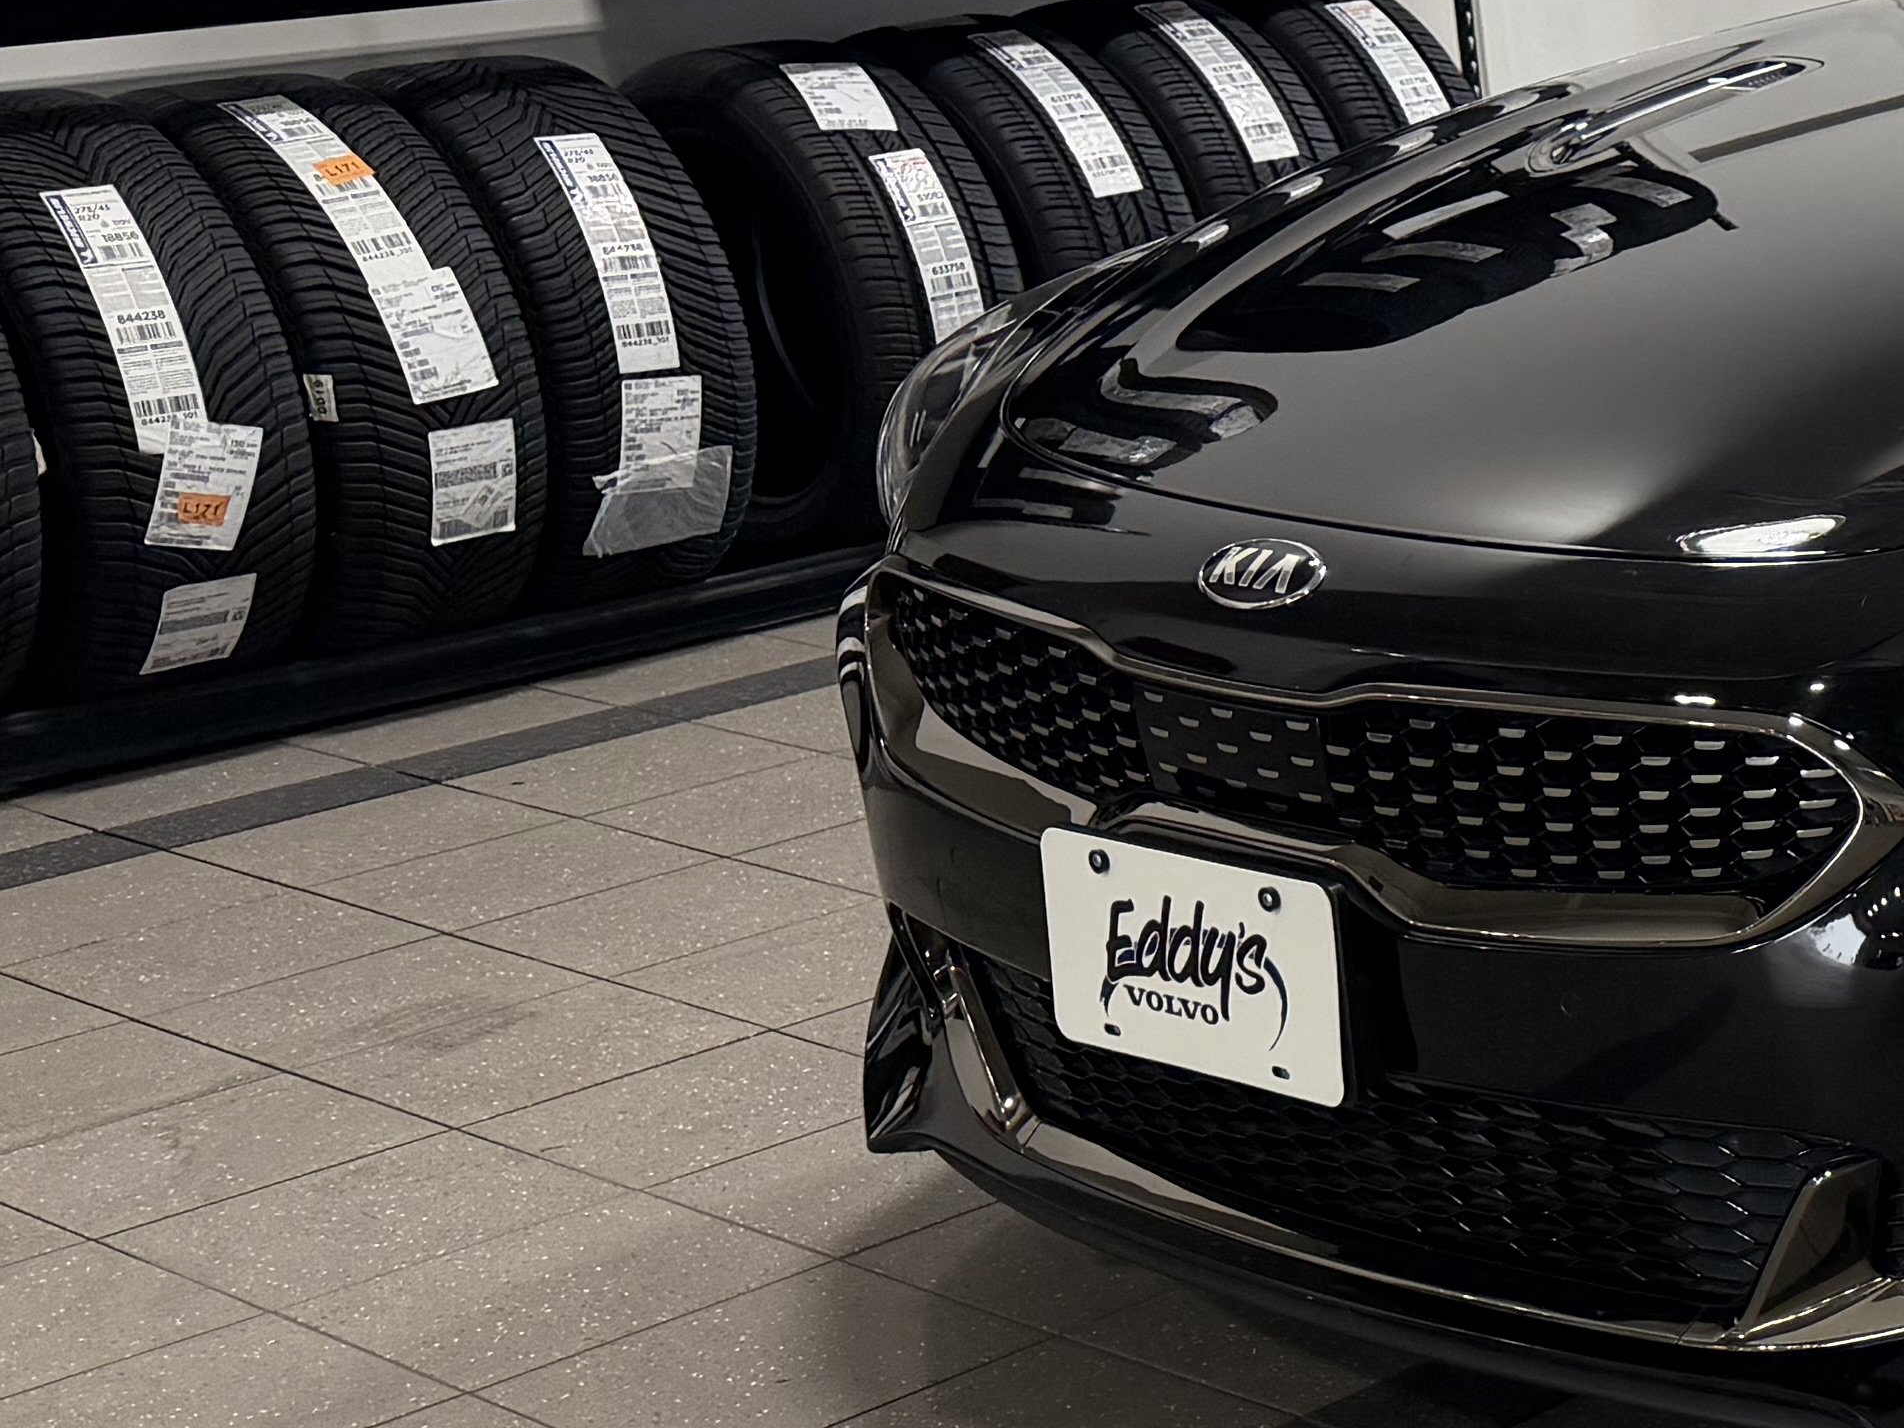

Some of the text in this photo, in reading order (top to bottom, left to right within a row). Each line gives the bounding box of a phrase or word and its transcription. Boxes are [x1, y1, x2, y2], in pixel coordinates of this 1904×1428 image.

[324, 160, 361, 178] L171
[74, 204, 111, 214] 275/45
[100, 230, 140, 243] 18856
[117, 310, 166, 324] 844238
[1208, 546, 1305, 594] KIA
[1106, 894, 1267, 1022] Eddy's
[1122, 984, 1219, 1025] VOLVO
